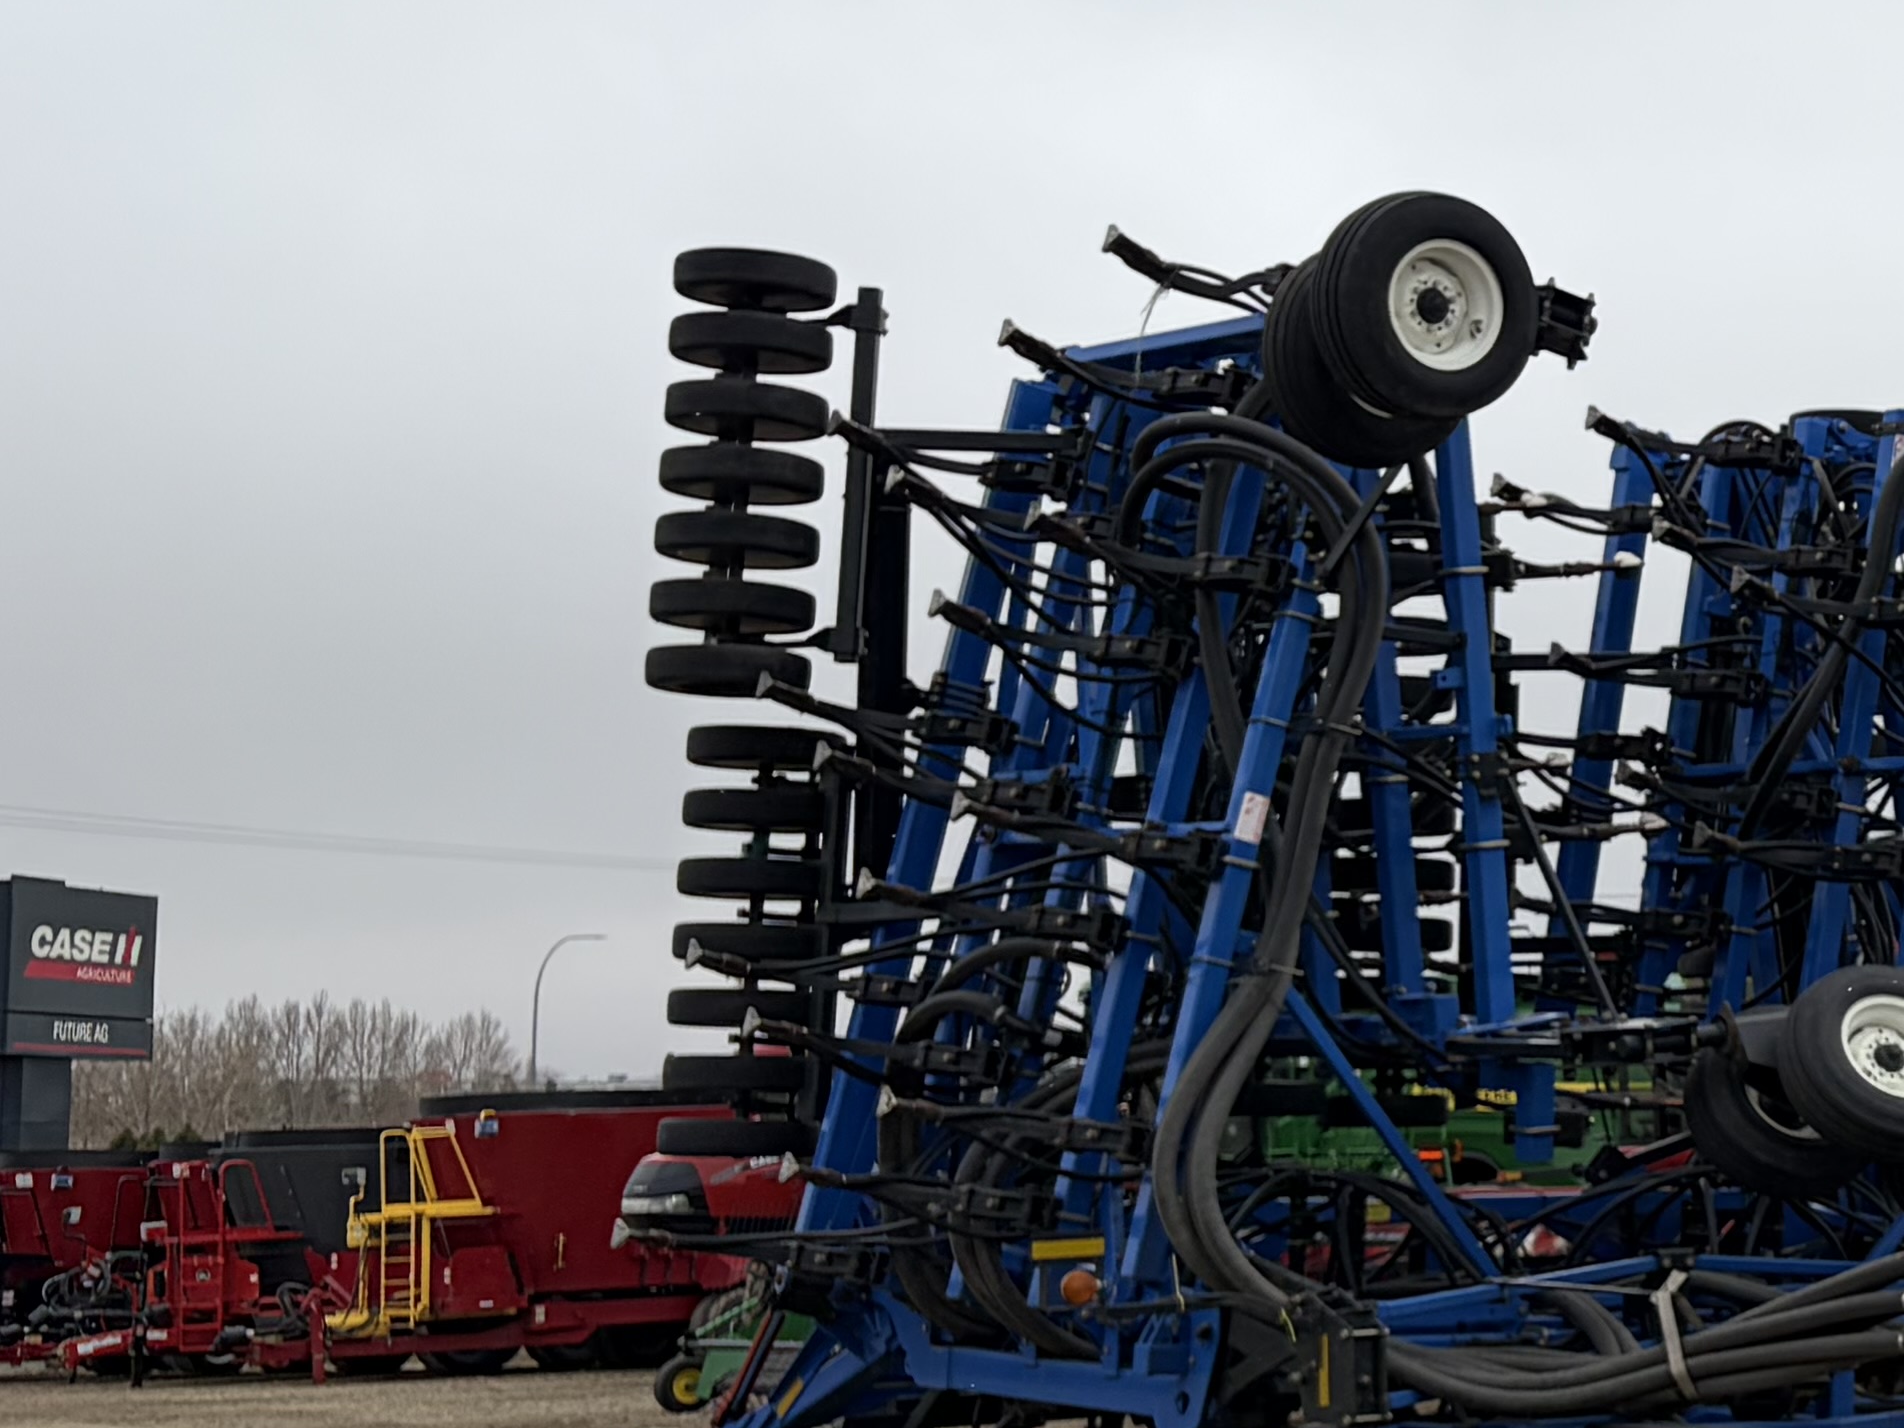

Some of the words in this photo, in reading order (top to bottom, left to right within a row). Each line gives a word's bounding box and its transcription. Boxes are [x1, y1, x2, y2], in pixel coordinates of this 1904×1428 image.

[31, 924, 114, 964] CASE
[76, 966, 133, 984] AGRICULTURE
[53, 1020, 93, 1043] FUTURE
[94, 1022, 109, 1044] AG
